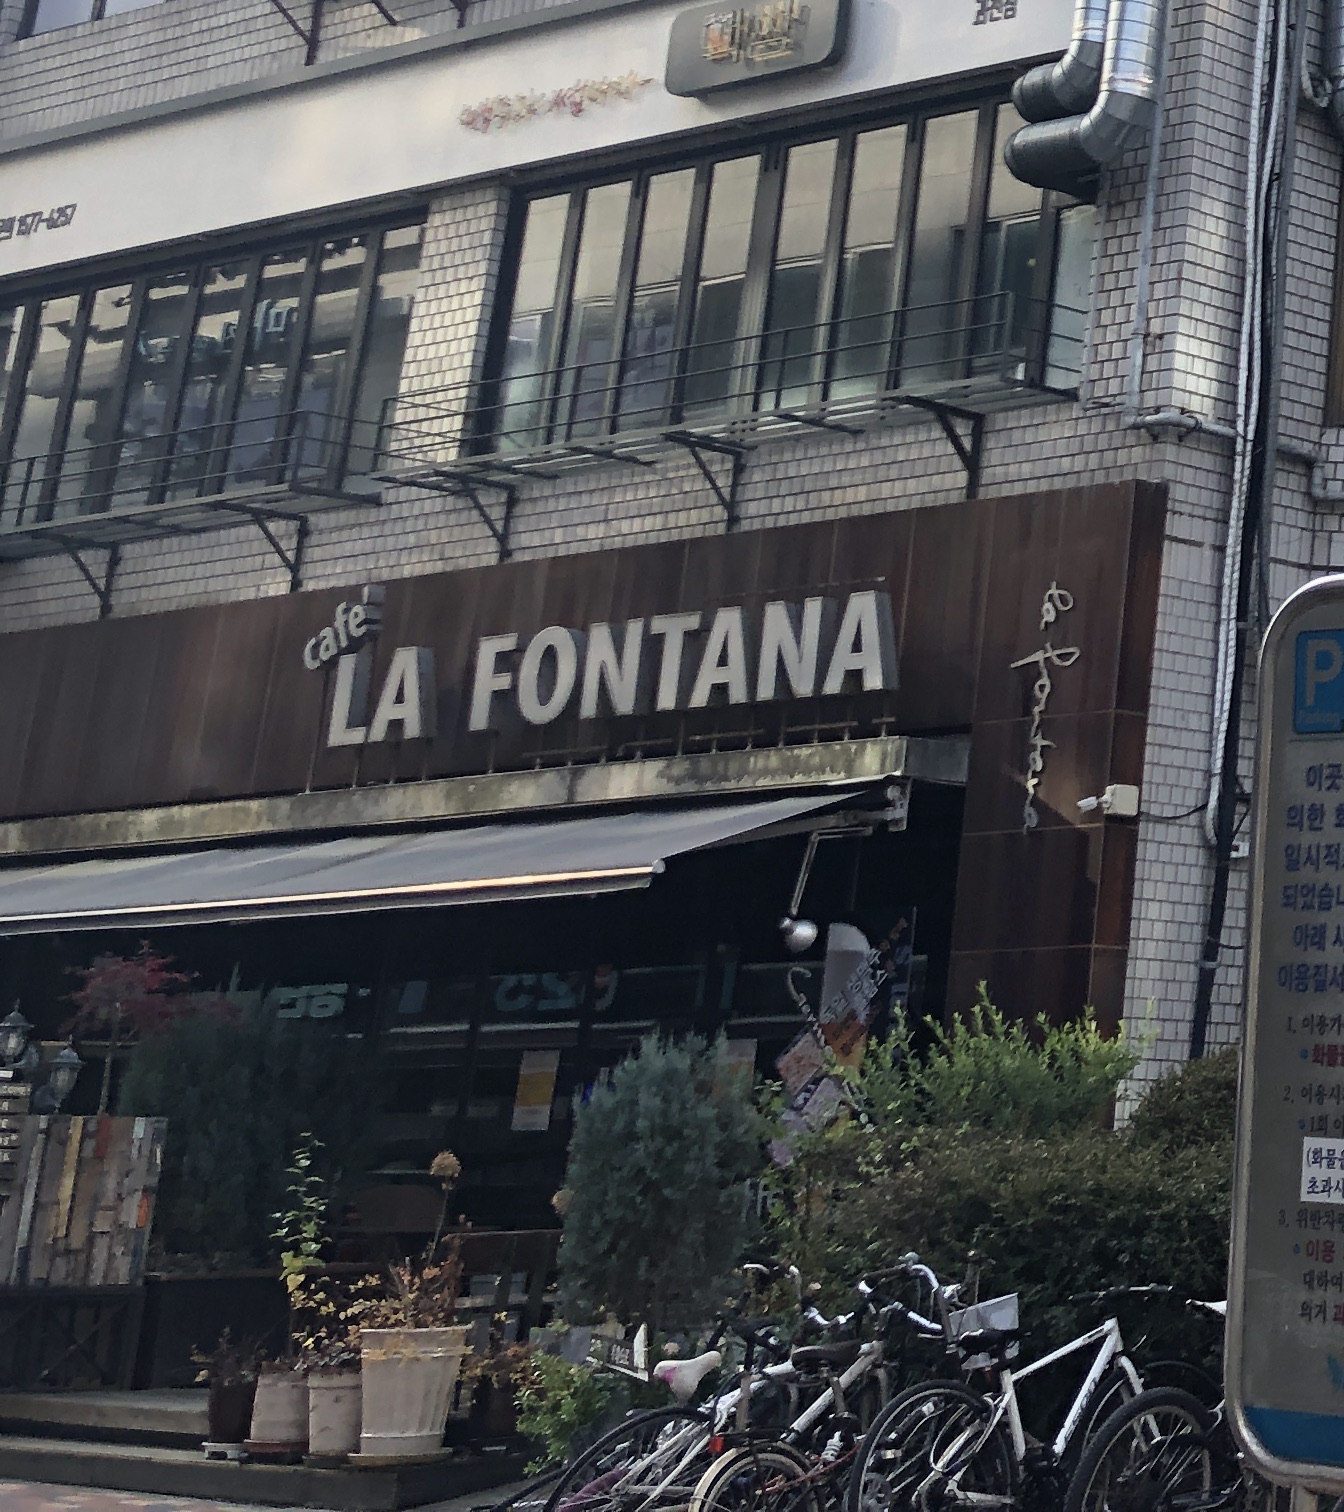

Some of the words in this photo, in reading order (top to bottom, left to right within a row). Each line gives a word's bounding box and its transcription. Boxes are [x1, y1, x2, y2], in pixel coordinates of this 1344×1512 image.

[326, 645, 428, 751] LA
[467, 589, 890, 734] FONTANA
[1285, 802, 1326, 832] 의한
[1305, 1239, 1336, 1263] 이용
